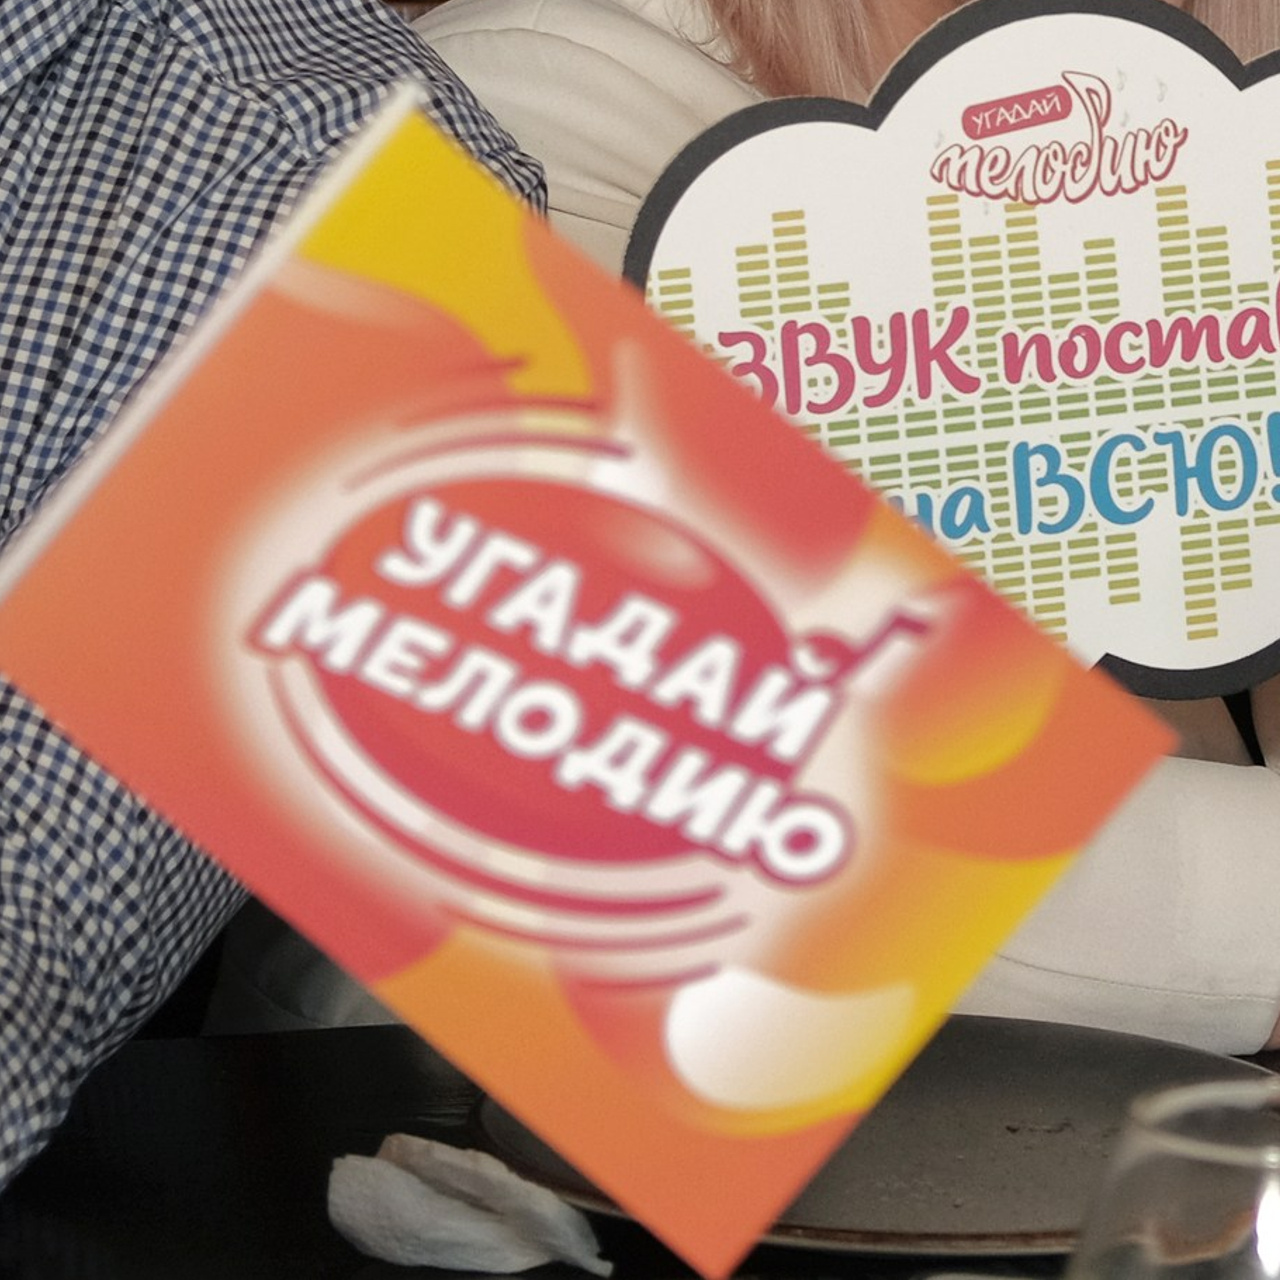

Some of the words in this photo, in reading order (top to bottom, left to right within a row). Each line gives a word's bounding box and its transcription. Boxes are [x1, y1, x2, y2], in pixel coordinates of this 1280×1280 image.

[929, 69, 1190, 206] мелодию
[971, 92, 1062, 136] УГАДАЙ
[718, 305, 982, 416] ЗВУК
[376, 495, 836, 766] УГАДАЙ
[258, 575, 846, 882] МЕЛОДИЮ
